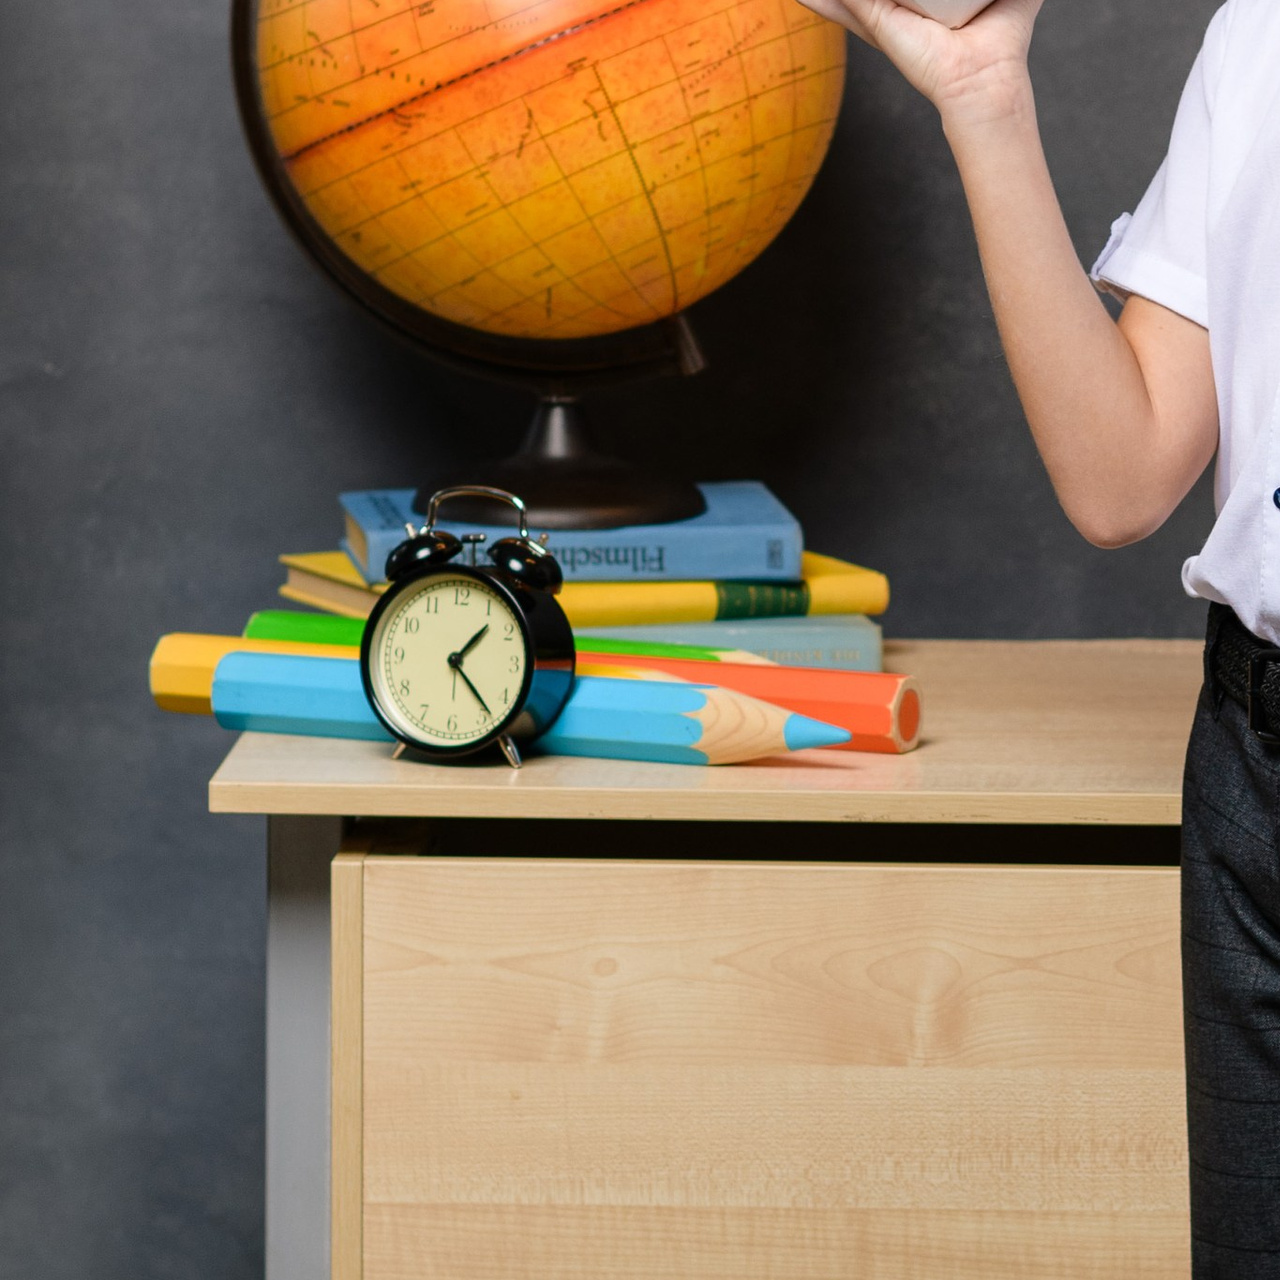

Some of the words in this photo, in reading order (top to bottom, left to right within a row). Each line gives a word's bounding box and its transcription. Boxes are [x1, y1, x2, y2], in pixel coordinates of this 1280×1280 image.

[426, 596, 439, 614] 11
[454, 588, 471, 606] 12
[485, 599, 491, 616] 1
[404, 617, 420, 634] 10
[503, 624, 514, 641] 2
[394, 647, 405, 665] 9
[508, 656, 520, 674] 3
[400, 679, 410, 697] 8
[498, 687, 509, 705] 4
[420, 704, 430, 721] 7
[476, 708, 488, 725] 5
[447, 714, 458, 732] 6
